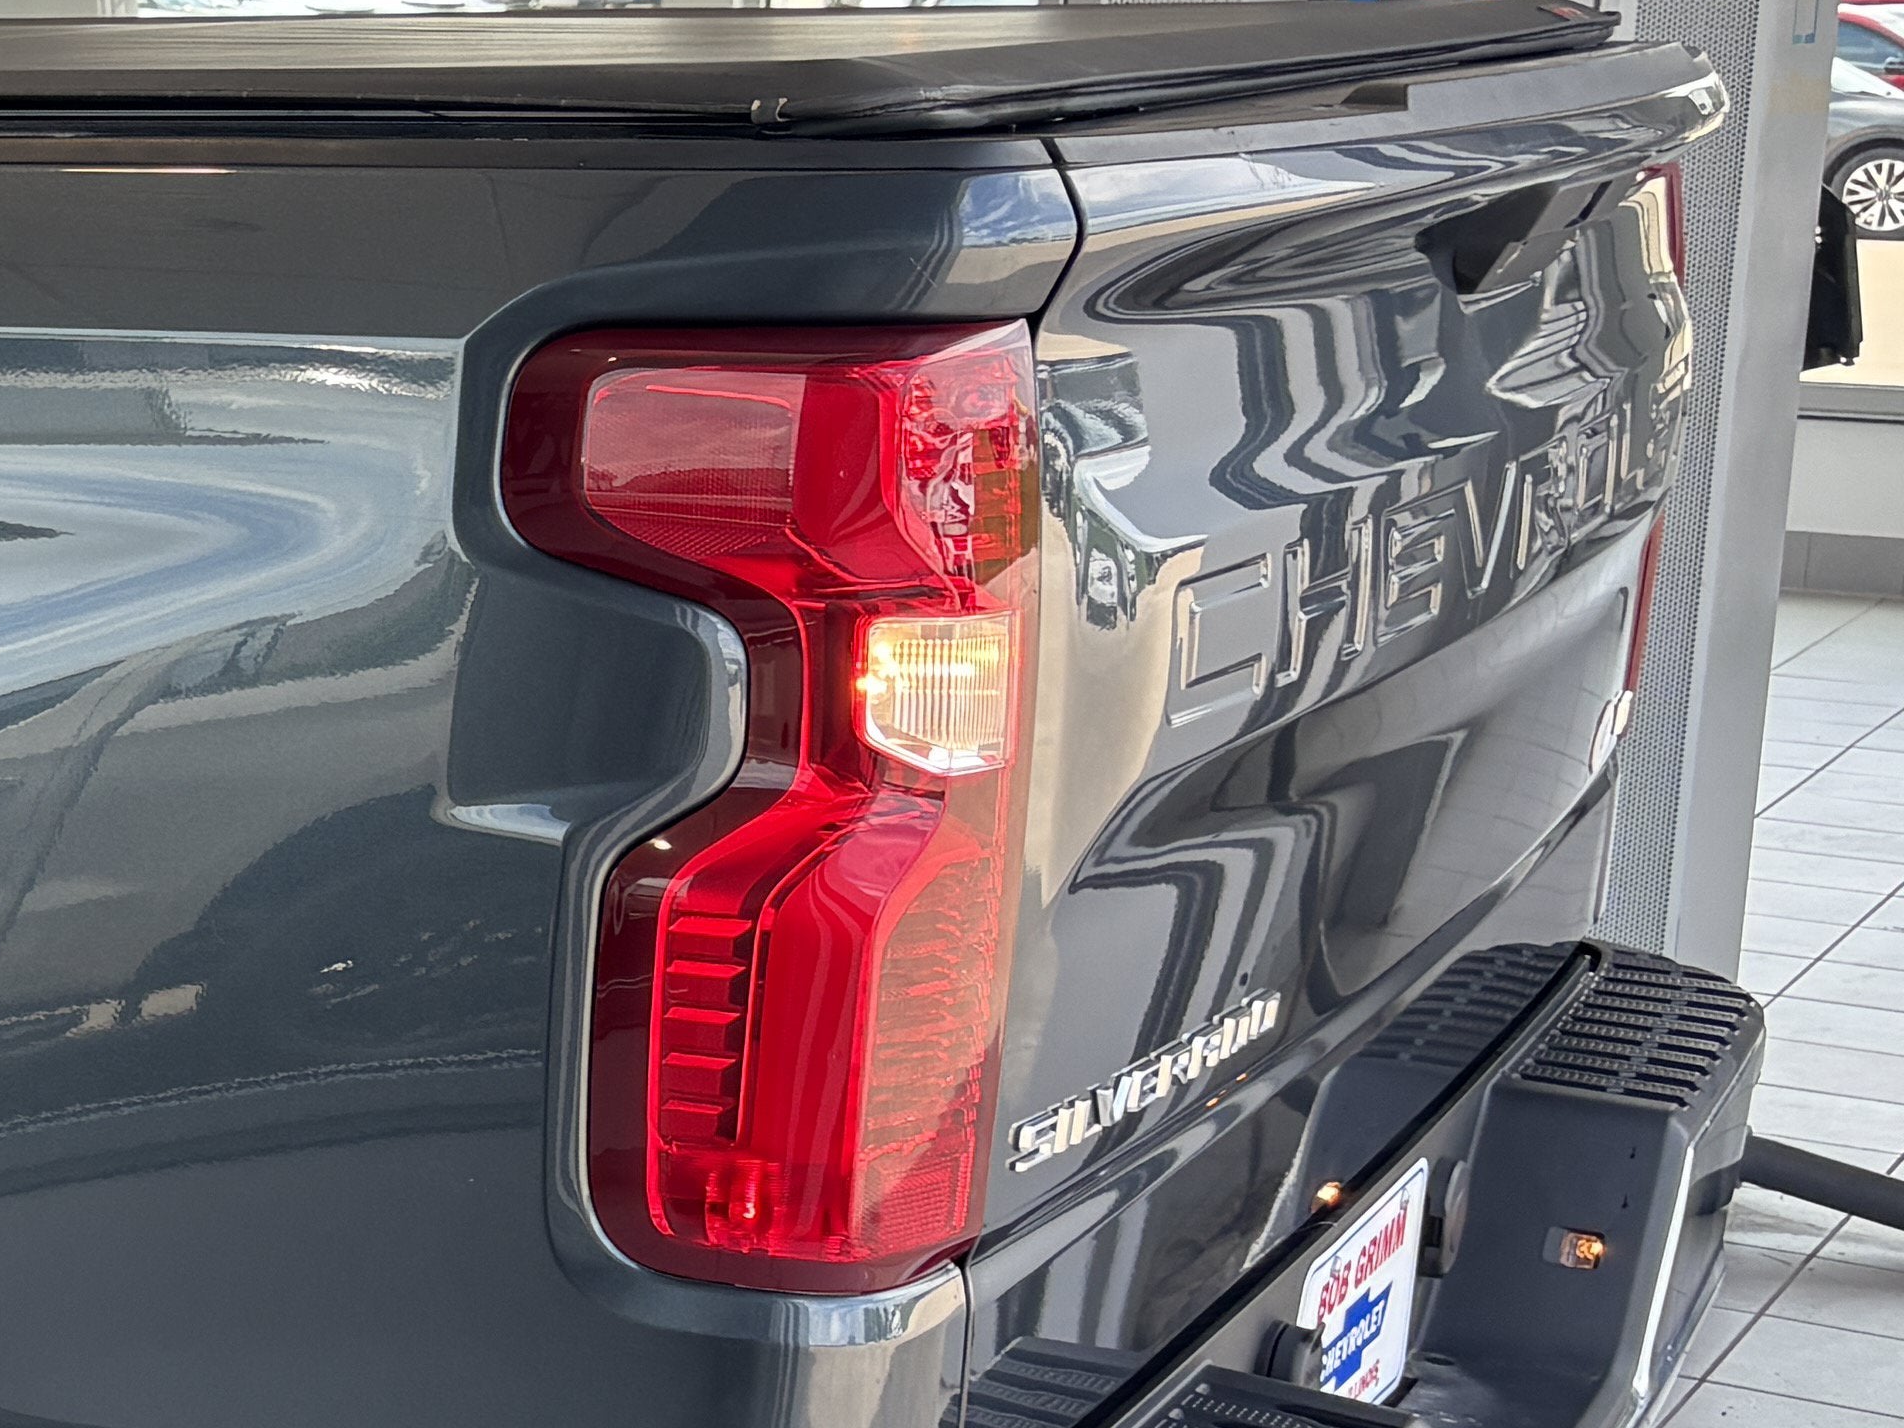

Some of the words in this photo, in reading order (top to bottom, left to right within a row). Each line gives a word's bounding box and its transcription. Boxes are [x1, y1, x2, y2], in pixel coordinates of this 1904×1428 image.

[1005, 987, 1281, 1173] SILVERADO
[1317, 1257, 1352, 1323] BOB
[1354, 1208, 1408, 1285] GRIMM
